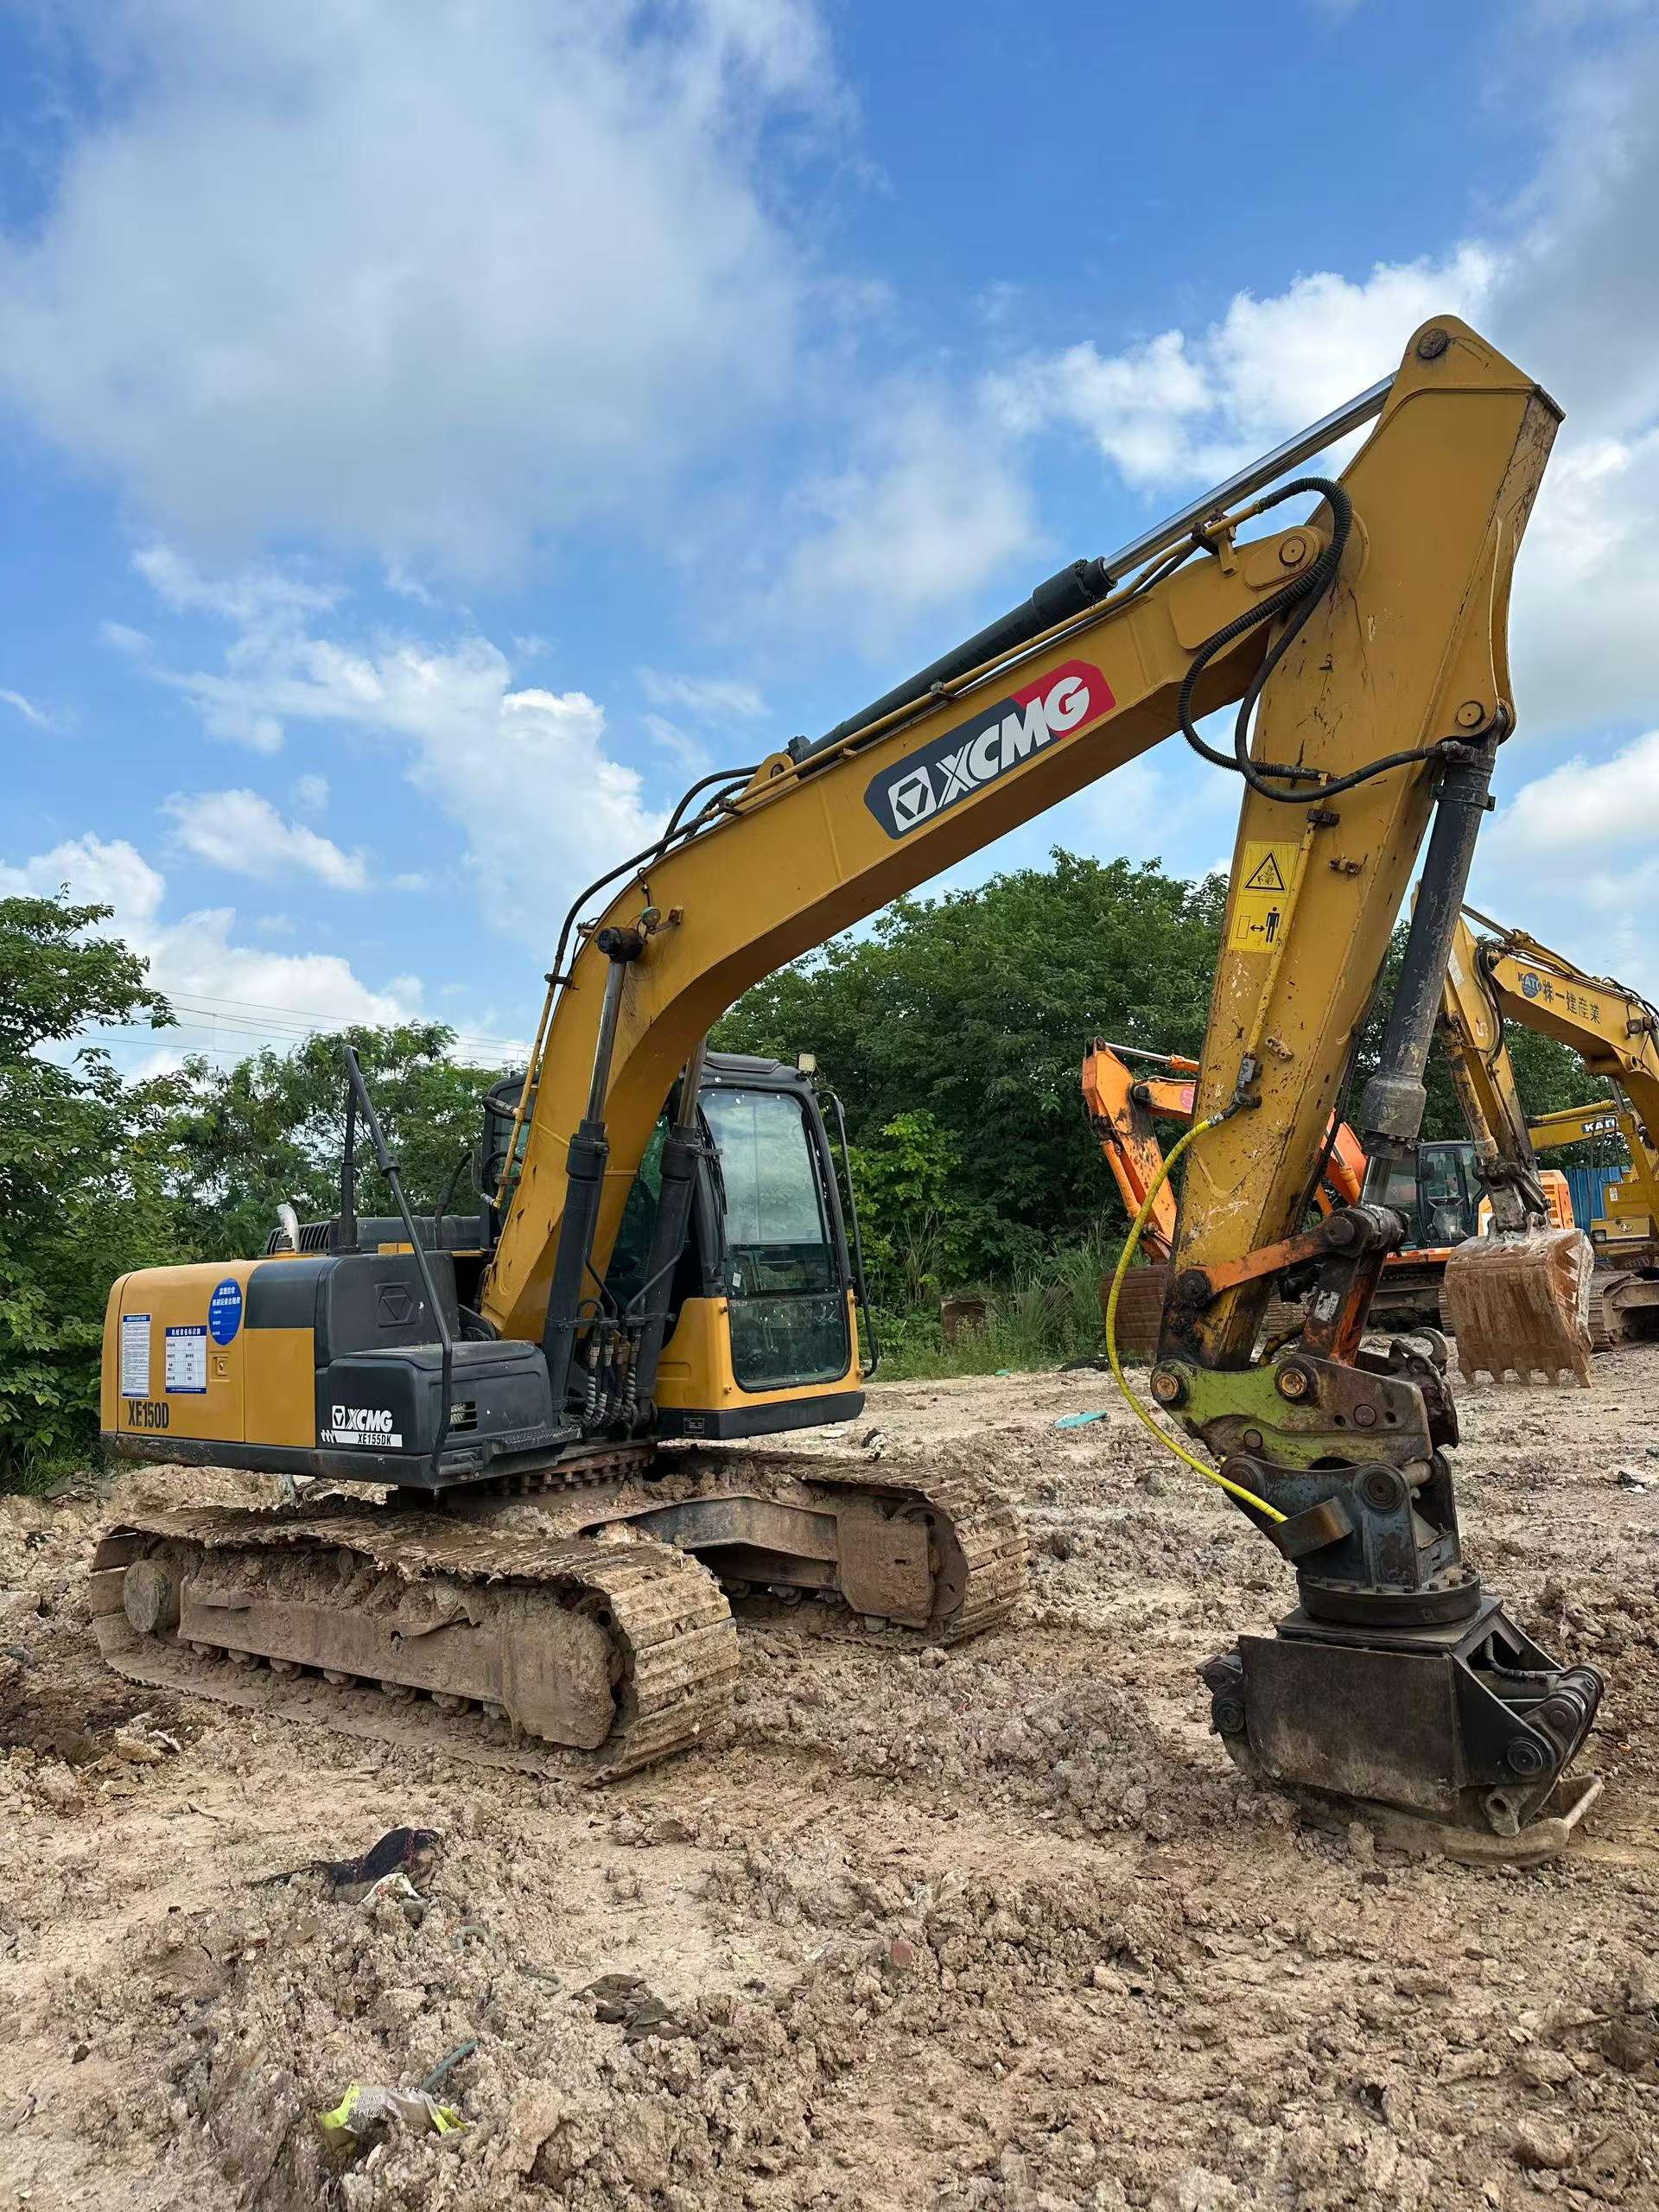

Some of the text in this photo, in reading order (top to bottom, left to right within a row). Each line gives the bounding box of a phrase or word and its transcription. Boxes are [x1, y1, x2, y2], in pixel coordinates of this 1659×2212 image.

[936, 676, 1090, 809] XCMG
[128, 1400, 169, 1428] XE150D
[346, 1408, 393, 1433] XCMG
[357, 1433, 392, 1446] XE155DK
